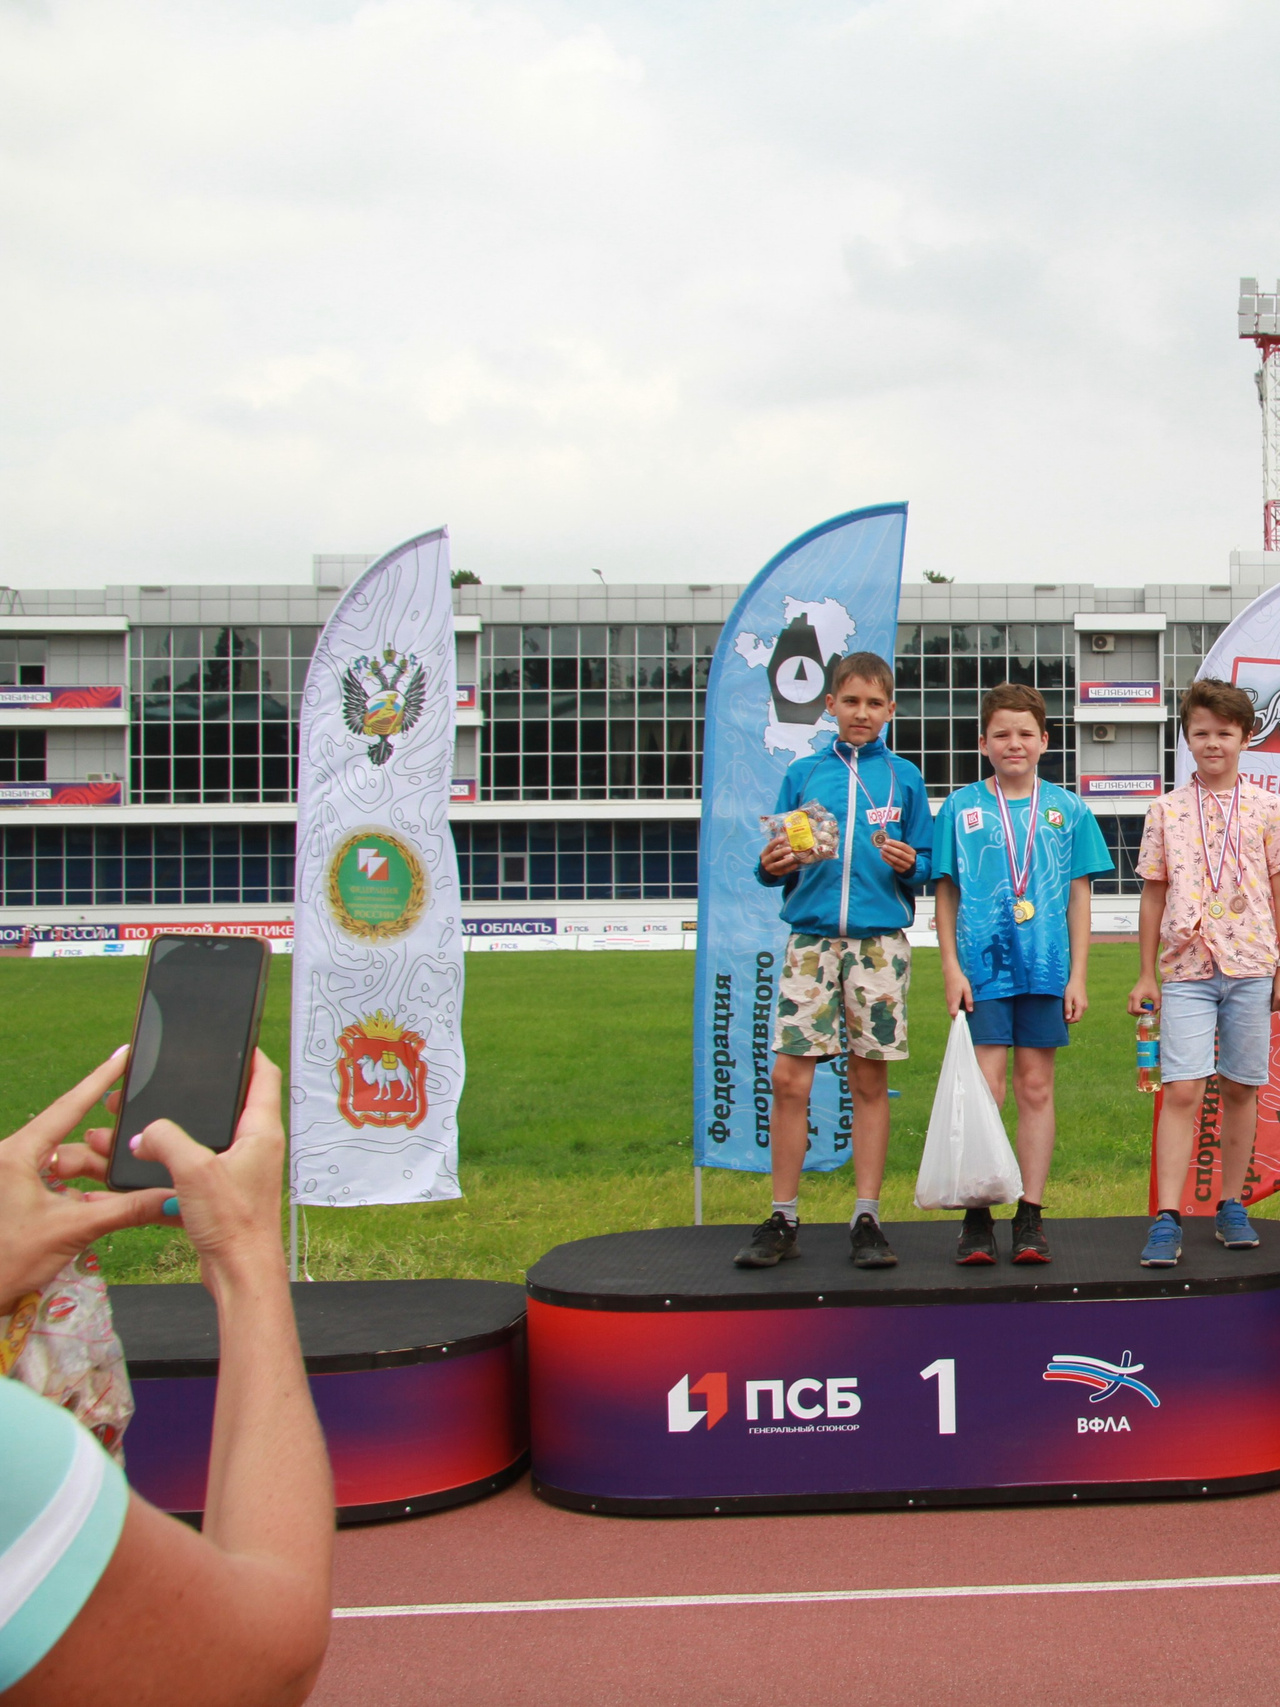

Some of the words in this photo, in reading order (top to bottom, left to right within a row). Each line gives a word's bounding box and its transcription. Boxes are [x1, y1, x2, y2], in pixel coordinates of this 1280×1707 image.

[1090, 688, 1151, 697] ЧЕЛЯБИНСК
[1091, 781, 1152, 790] ЧЕЛЯБИНСК
[125, 927, 148, 939] ПО
[218, 924, 294, 936] АТЛЕТИКЕ
[480, 922, 552, 934] ОБЛАСТЬ
[752, 951, 774, 1148] спортивного
[708, 973, 735, 1143] Федерация
[746, 1377, 861, 1420] ПСБ
[919, 1358, 956, 1434] 1
[748, 1424, 815, 1434] ГЕНЕРАЛЬНЫЙ
[816, 1423, 860, 1433] СПОНСОР
[1077, 1416, 1131, 1434] ВФЛА
